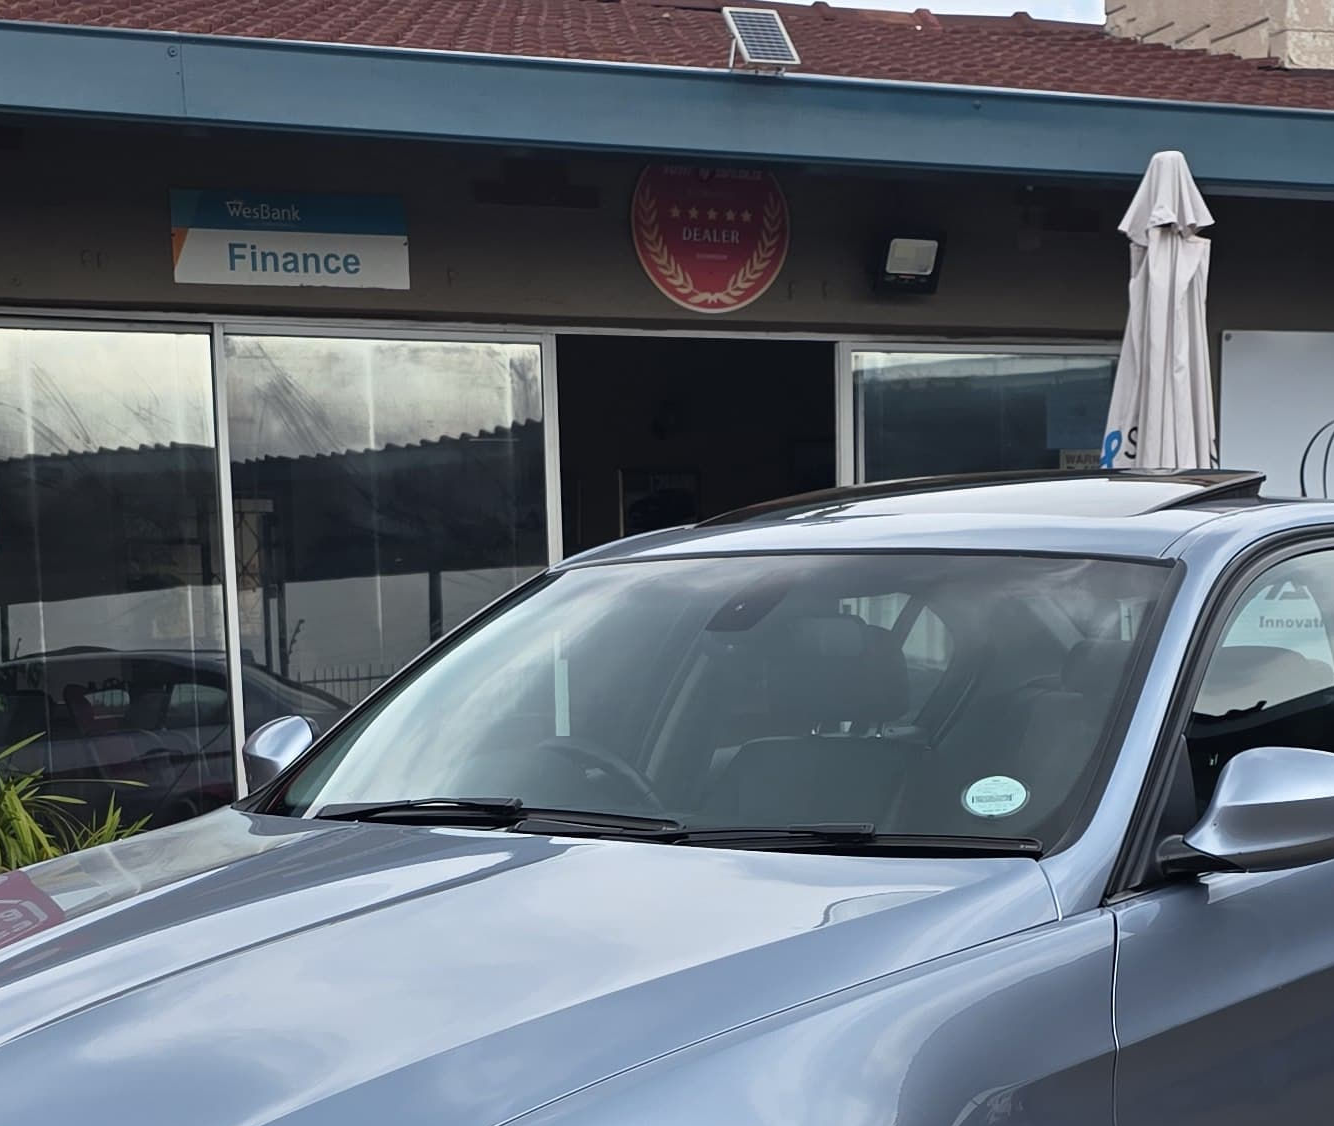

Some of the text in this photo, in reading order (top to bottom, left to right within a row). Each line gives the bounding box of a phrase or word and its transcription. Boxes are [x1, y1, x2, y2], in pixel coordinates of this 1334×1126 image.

[225, 199, 301, 222] WesBank
[682, 226, 740, 244] DEALER
[228, 242, 361, 275] Finance
